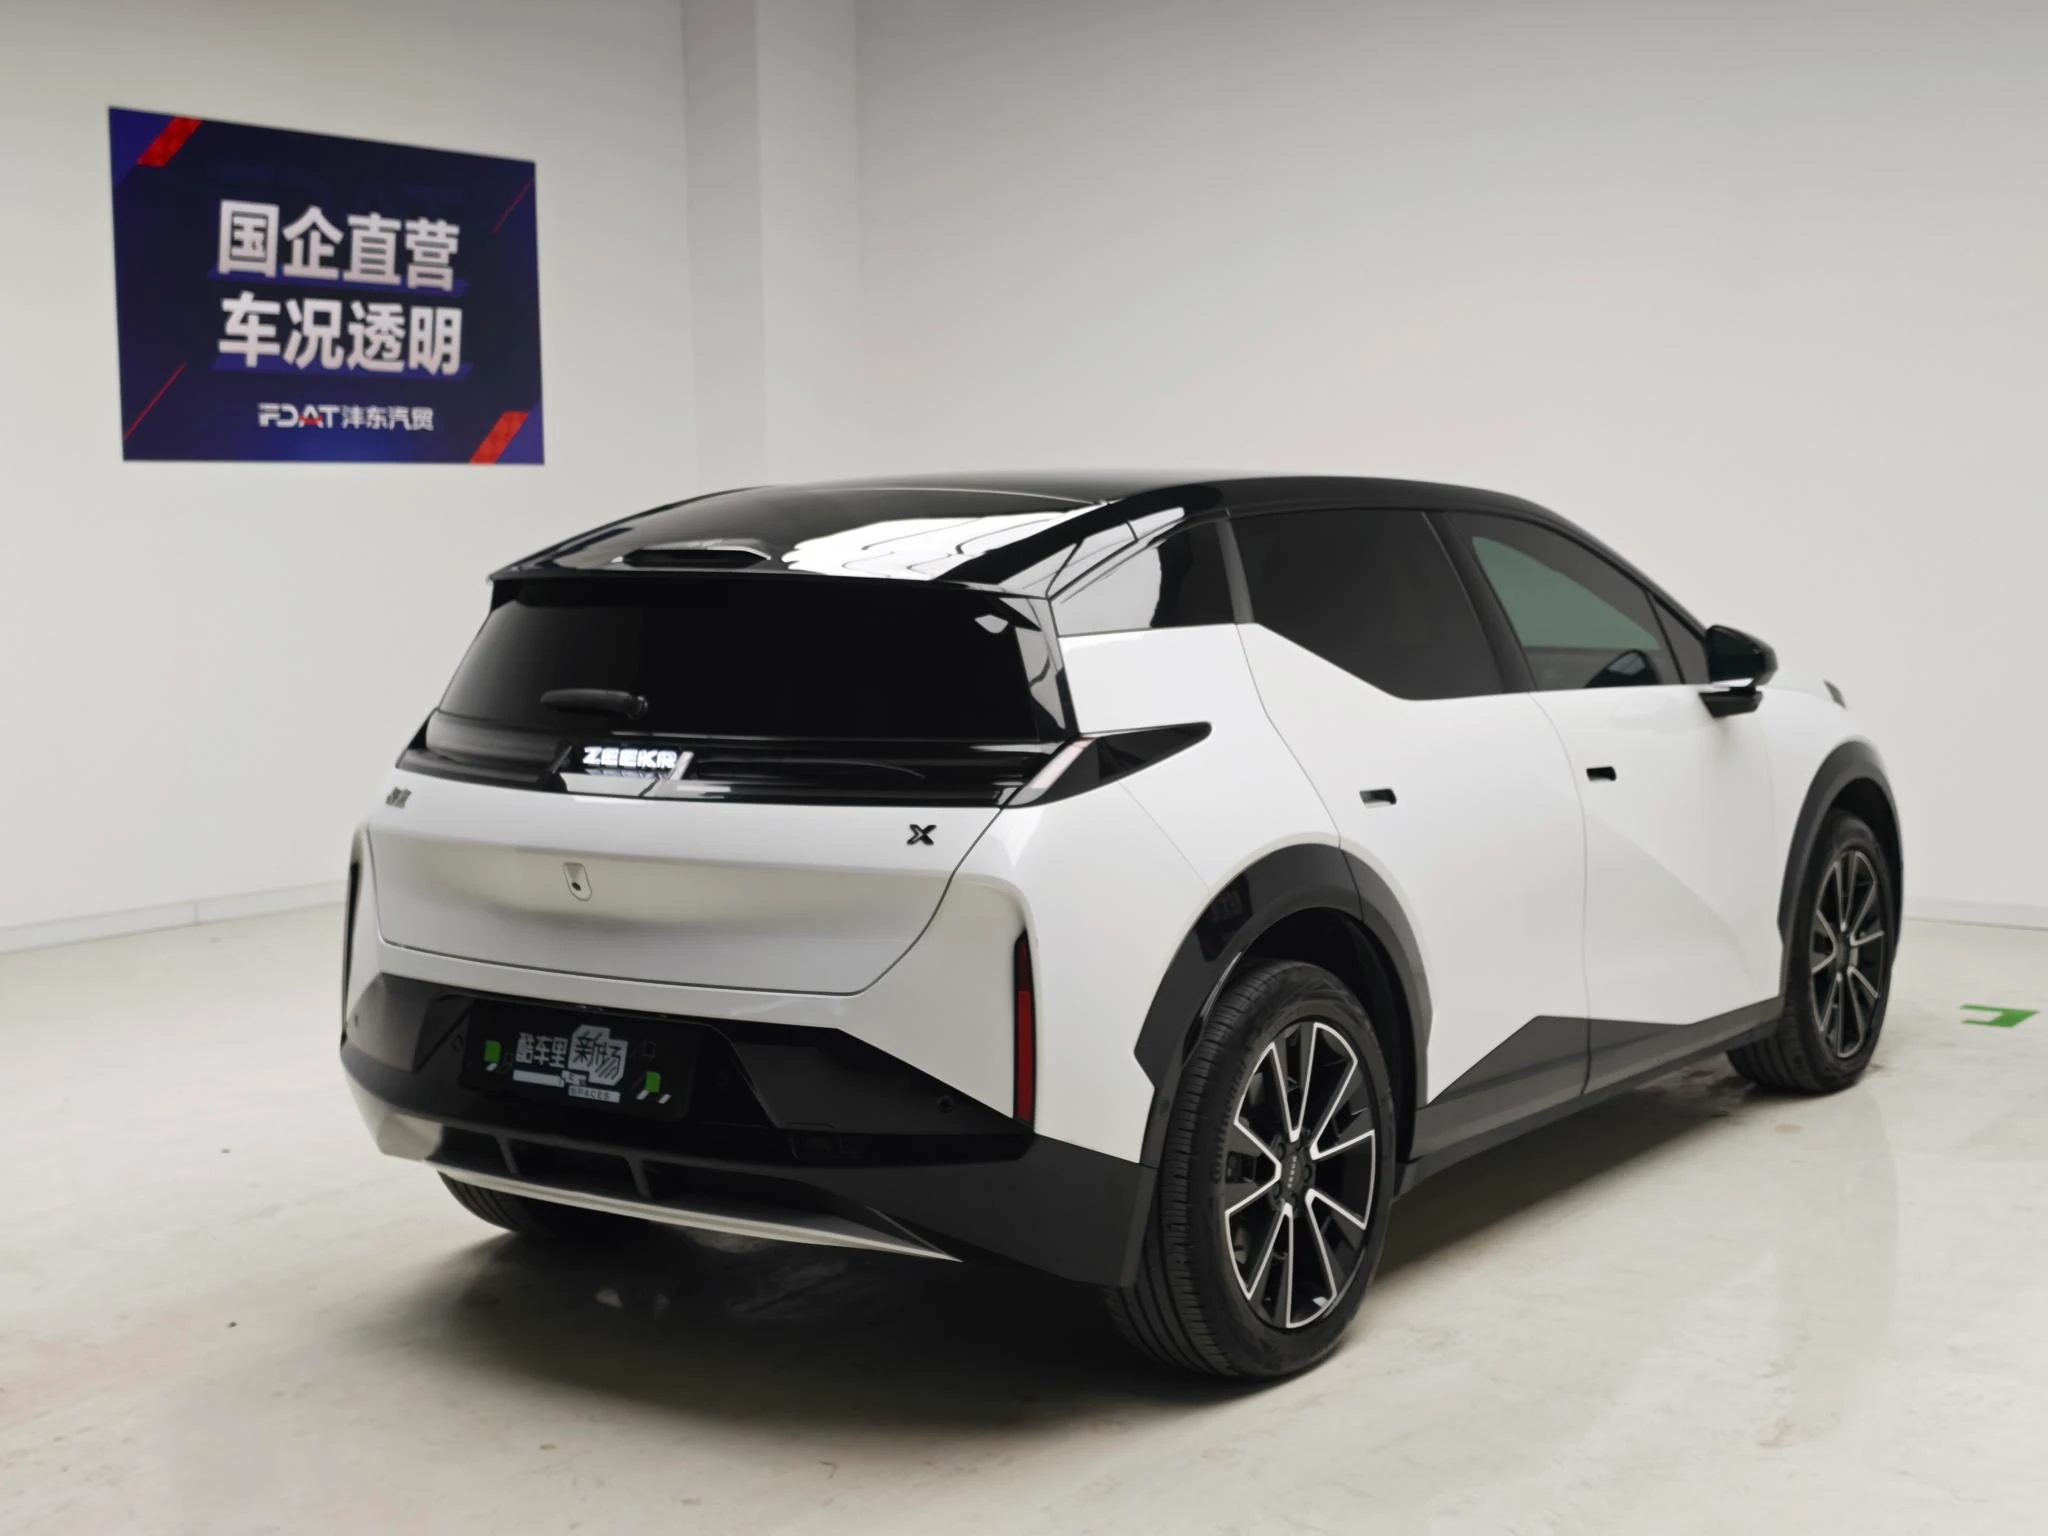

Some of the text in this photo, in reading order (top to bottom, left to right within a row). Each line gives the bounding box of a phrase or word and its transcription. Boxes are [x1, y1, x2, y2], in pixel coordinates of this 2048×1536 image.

[217, 199, 460, 291] 国企直营
[217, 290, 463, 376] 车况透明
[257, 402, 434, 431] FDAT 沣东汽贸
[582, 746, 677, 768] ZEEKR
[906, 824, 937, 846] X
